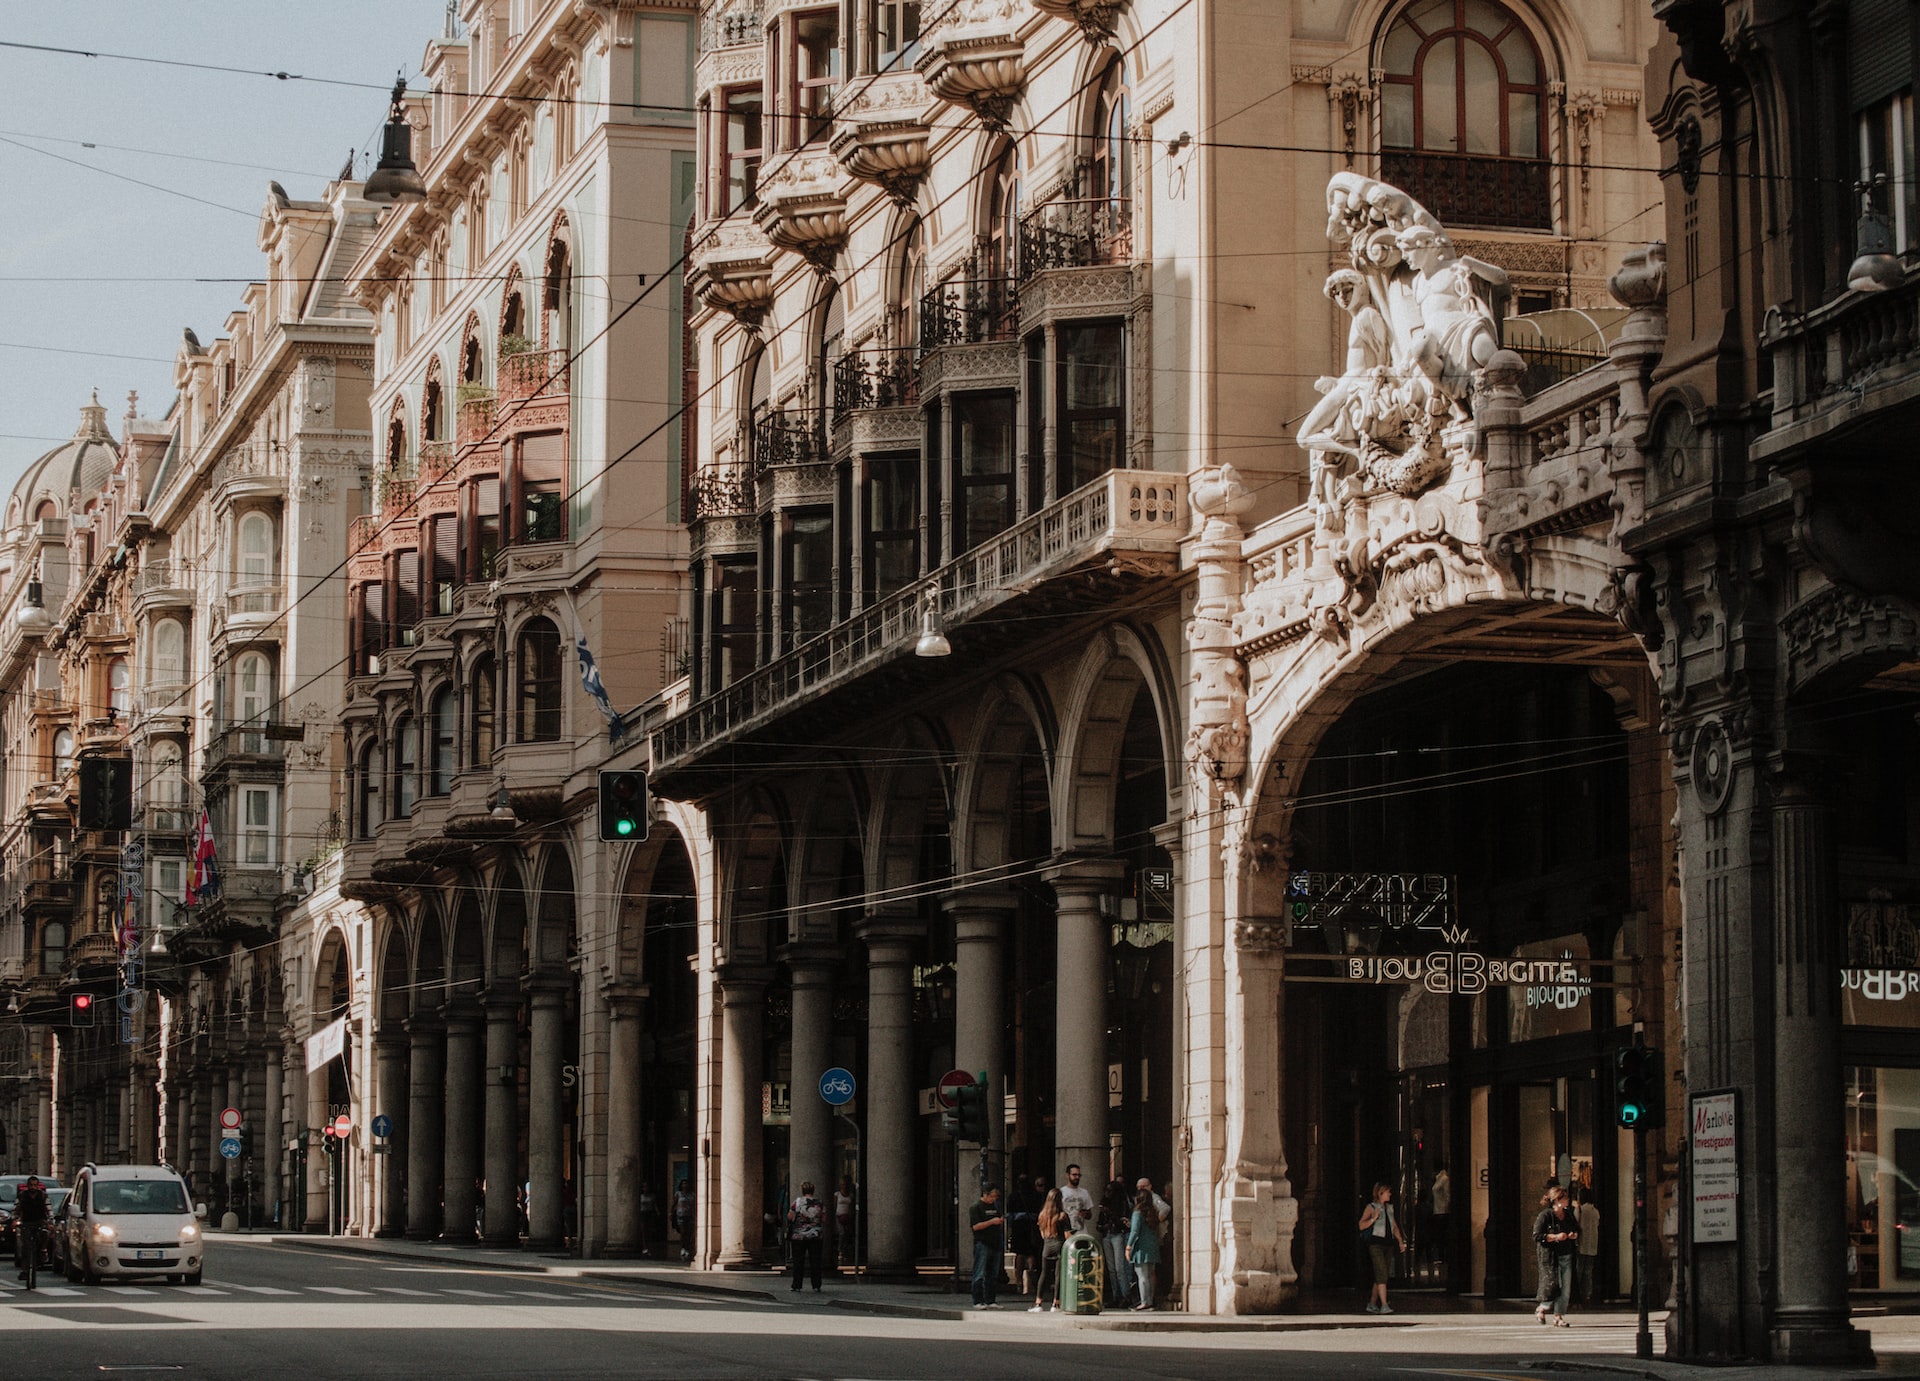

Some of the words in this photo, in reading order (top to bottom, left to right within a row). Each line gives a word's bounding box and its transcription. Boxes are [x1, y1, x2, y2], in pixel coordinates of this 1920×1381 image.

[118, 842, 144, 1044] BRISTOL
[1348, 957, 1422, 984] BIJOU
[1456, 951, 1573, 994] BRIGITTE
[1526, 985, 1556, 1010] BIJOU
[1694, 1135, 1734, 1151] Investigazioni
